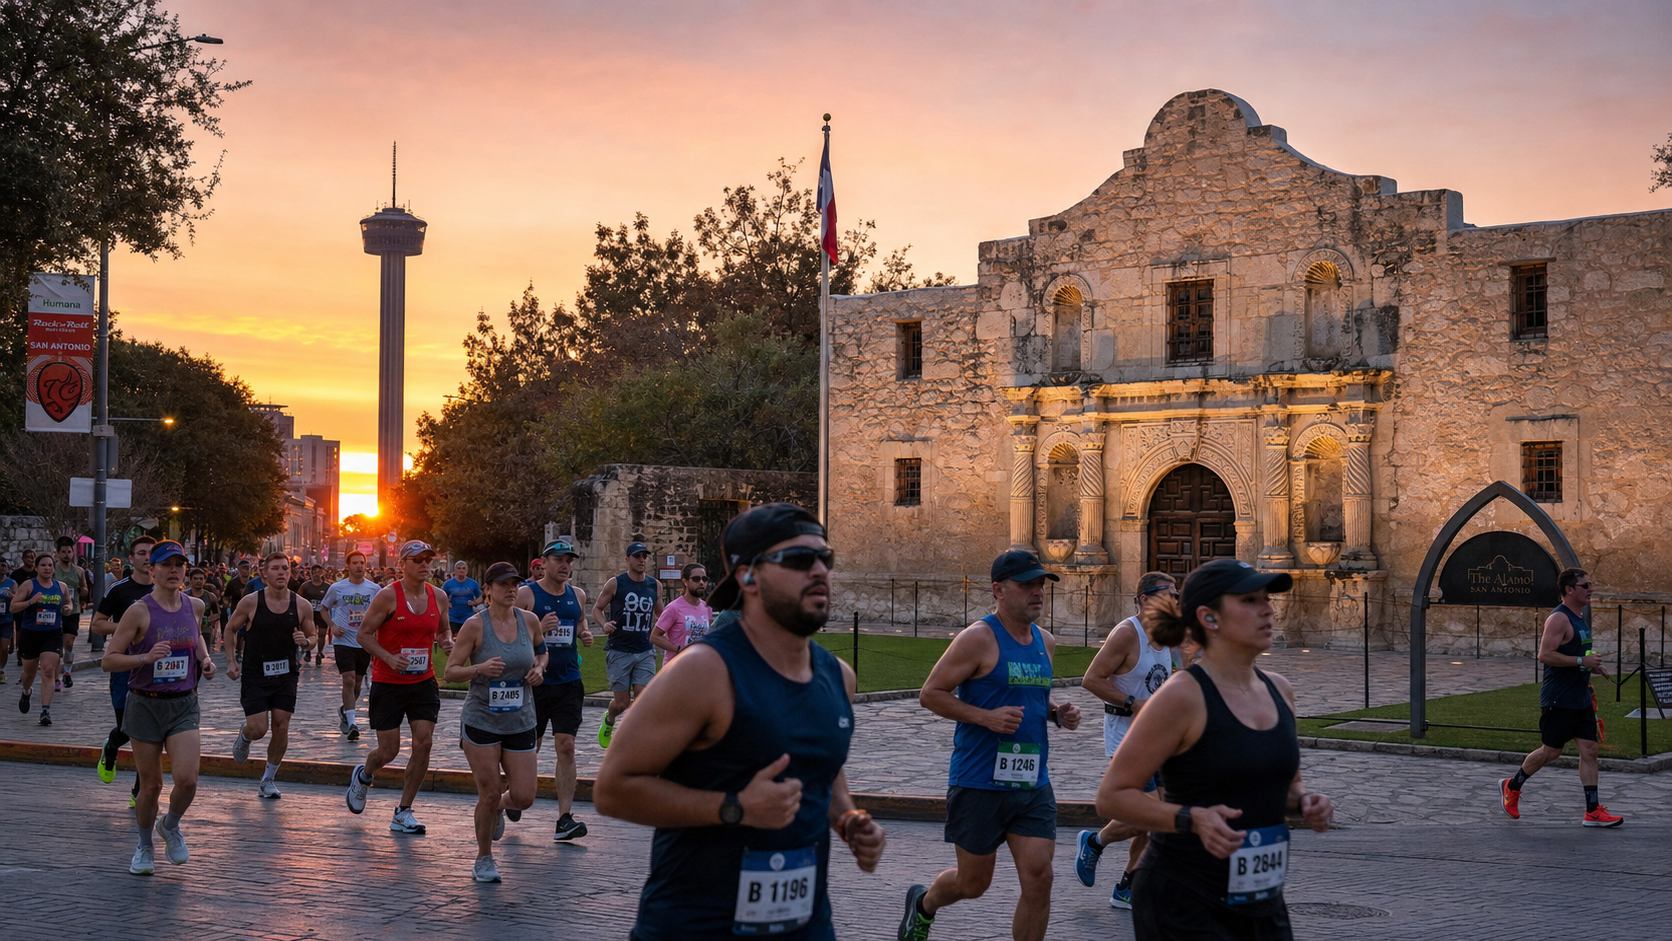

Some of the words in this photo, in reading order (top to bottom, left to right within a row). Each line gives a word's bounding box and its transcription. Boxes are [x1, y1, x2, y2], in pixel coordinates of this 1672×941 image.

[43, 299, 81, 309] Humana
[33, 319, 57, 328] Rock
[66, 320, 89, 329] Roll
[30, 341, 48, 350] SAN
[50, 342, 91, 351] ANTONIO
[1470, 572, 1491, 584] The
[1490, 586, 1531, 594] ANTONIO
[492, 690, 498, 700] B
[1000, 757, 1008, 770] B
[1011, 757, 1035, 771] 1246
[1237, 856, 1248, 876] B
[1253, 850, 1283, 875] 2844
[747, 881, 762, 904] B
[769, 876, 808, 903] 1196
